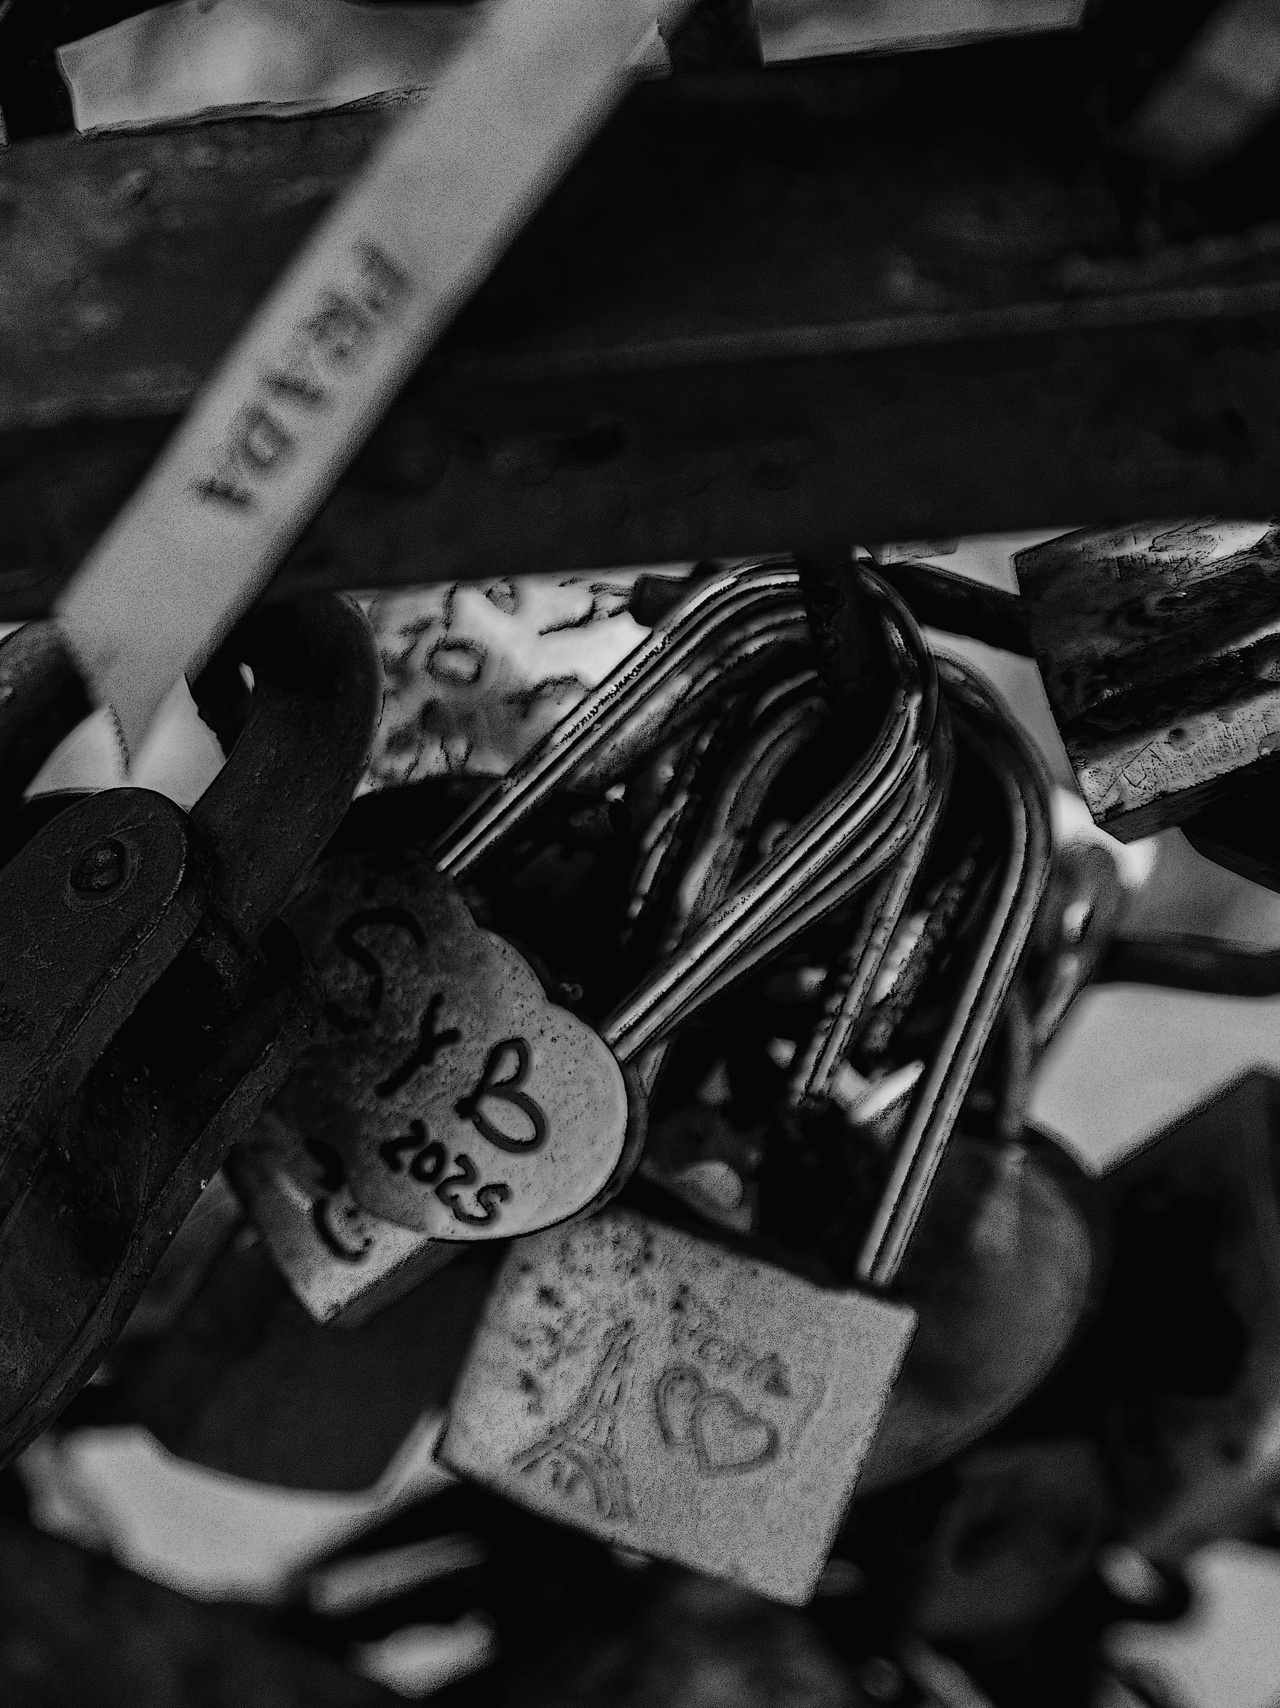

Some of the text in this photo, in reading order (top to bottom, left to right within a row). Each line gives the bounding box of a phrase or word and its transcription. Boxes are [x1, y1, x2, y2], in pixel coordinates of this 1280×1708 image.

[190, 238, 413, 512] PRADA
[456, 1037, 550, 1153] B
[379, 1119, 514, 1227] 2025
